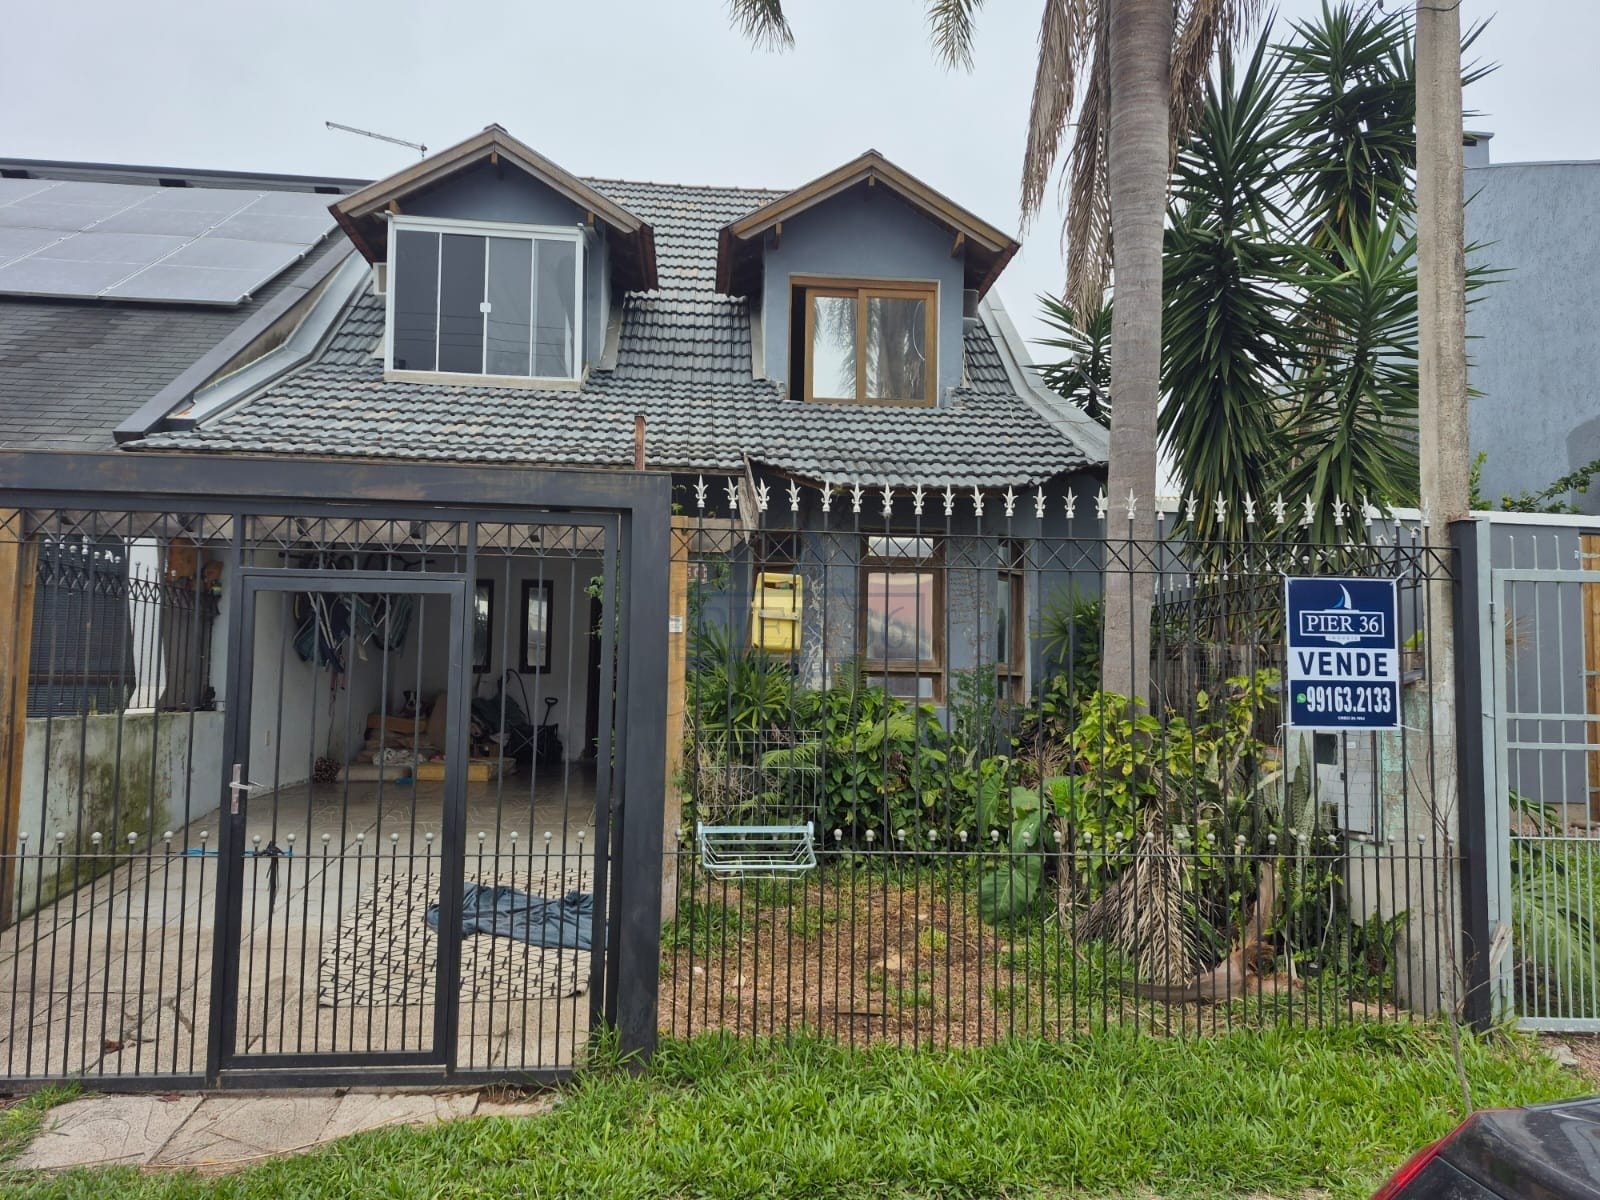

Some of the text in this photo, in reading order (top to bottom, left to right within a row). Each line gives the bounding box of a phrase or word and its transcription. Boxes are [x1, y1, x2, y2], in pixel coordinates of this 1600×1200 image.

[1306, 615, 1379, 633] PIER 36
[1297, 651, 1388, 677] VENDE
[1306, 685, 1391, 713] 99163.2133
